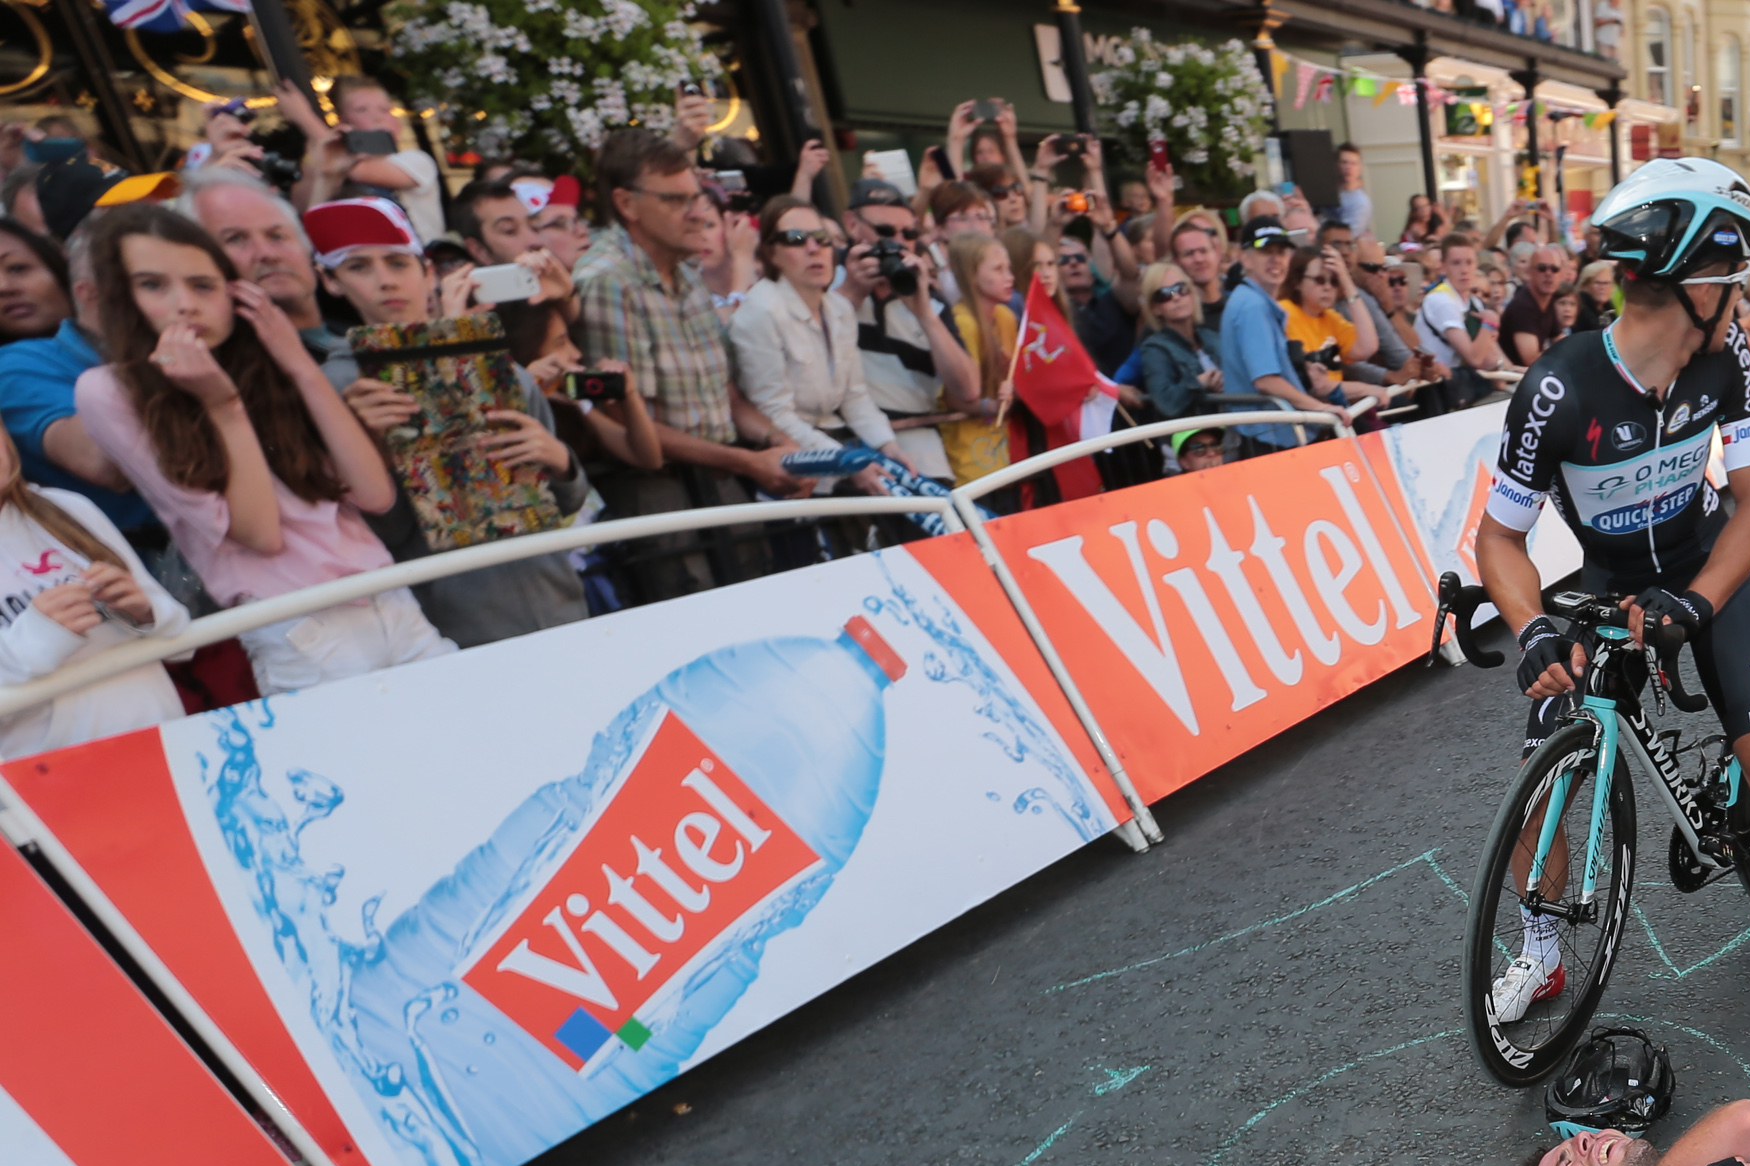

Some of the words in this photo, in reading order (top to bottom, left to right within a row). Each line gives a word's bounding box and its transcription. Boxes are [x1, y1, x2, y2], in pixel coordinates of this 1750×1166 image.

[1511, 375, 1566, 482] latexco
[1027, 465, 1421, 735] Vittel
[1522, 749, 1597, 829] ZIPP
[496, 766, 772, 1011] Vittel
